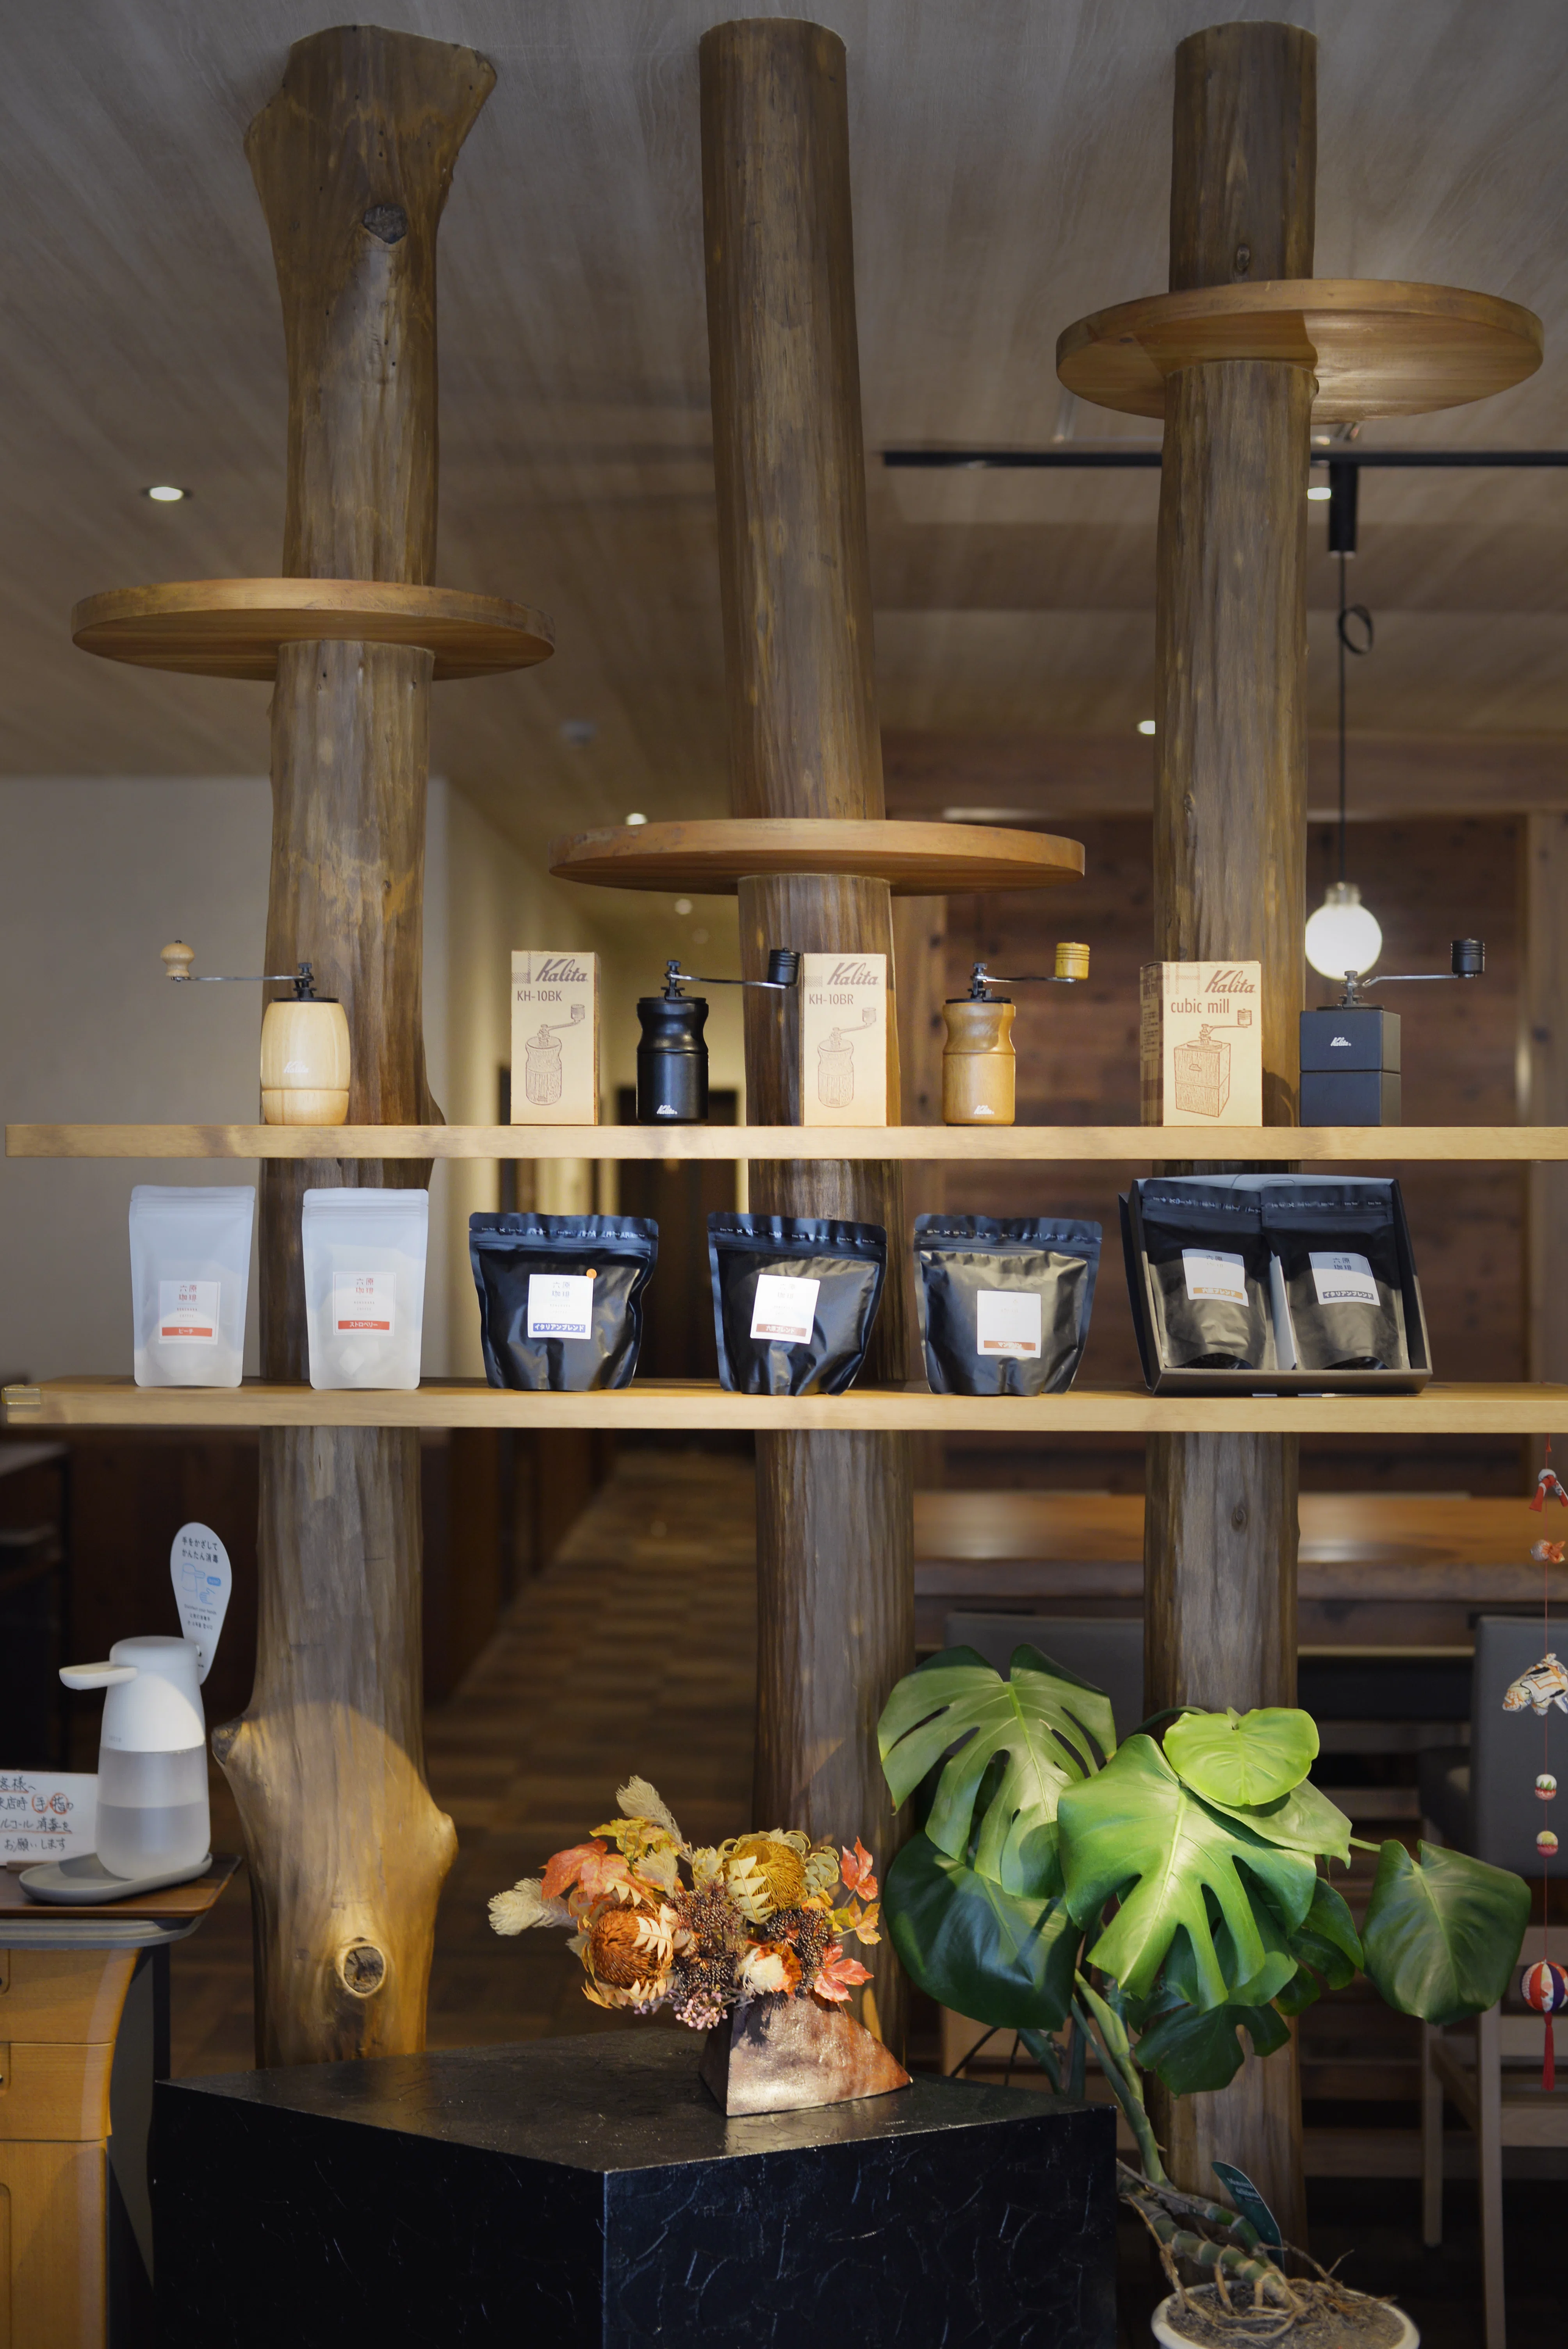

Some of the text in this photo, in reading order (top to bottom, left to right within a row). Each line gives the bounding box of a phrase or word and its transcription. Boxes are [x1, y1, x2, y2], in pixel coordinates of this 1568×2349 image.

[536, 959, 587, 982] Kalita
[827, 962, 878, 985] Kalita
[1205, 970, 1255, 993] Kalita
[517, 991, 562, 1002] KH-10BK
[809, 994, 853, 1005] KH-10BR
[1171, 998, 1229, 1014] cubic mill
[180, 1285, 197, 1293] 六原
[356, 1278, 374, 1286] 六原
[179, 1294, 197, 1302] 珈琲
[1324, 1290, 1373, 1299] イタリアンブレンド
[182, 1536, 217, 1551] 手をかざして
[182, 1549, 218, 1563] かんたん消毒
[5, 1837, 66, 1852] お願いします
